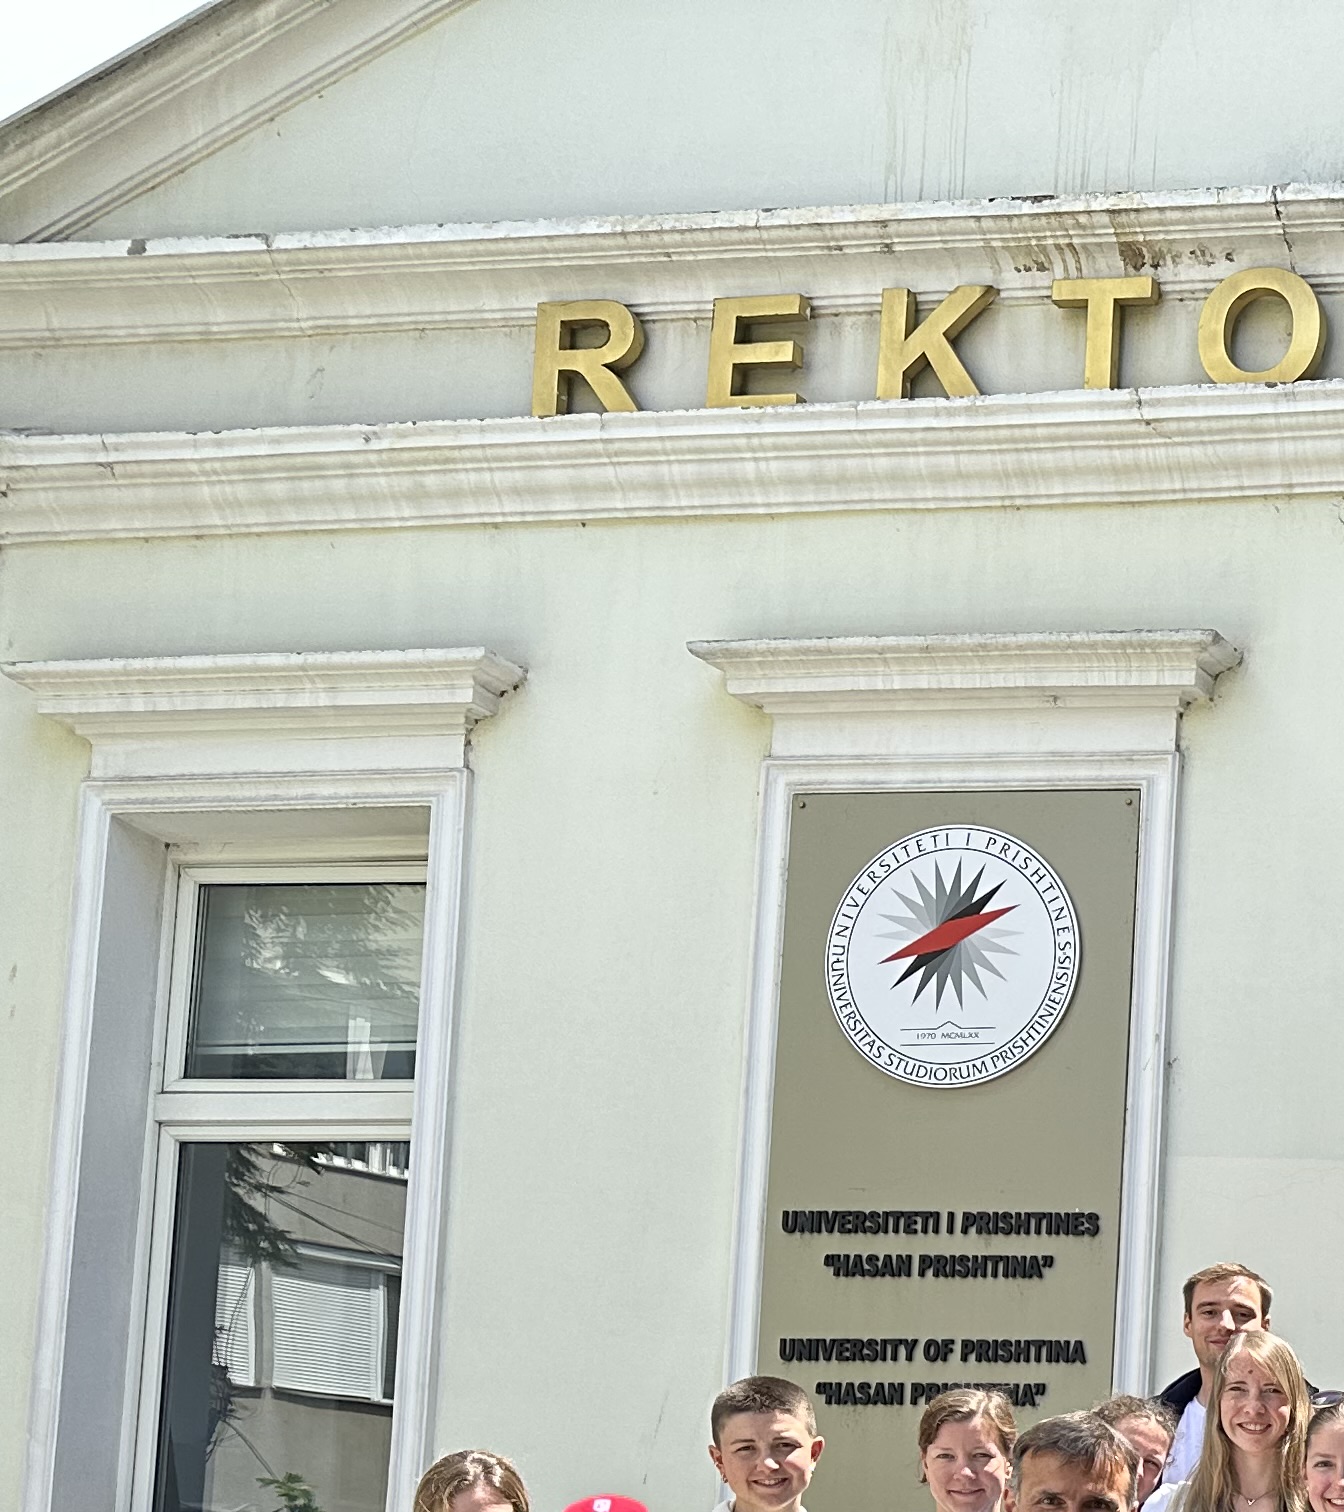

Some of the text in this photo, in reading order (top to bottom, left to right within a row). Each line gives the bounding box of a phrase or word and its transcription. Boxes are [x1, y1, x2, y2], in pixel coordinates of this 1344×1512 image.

[832, 832, 950, 958] UNIVERSITETI
[831, 955, 1072, 1082] UNIVERSITAS STUDIORUM PRISHTINIENSIS
[782, 1210, 1099, 1237] UNIVERSITETI I PRISHTINES
[779, 1338, 1087, 1364] UNIVERSITY OF PRISHTINA
